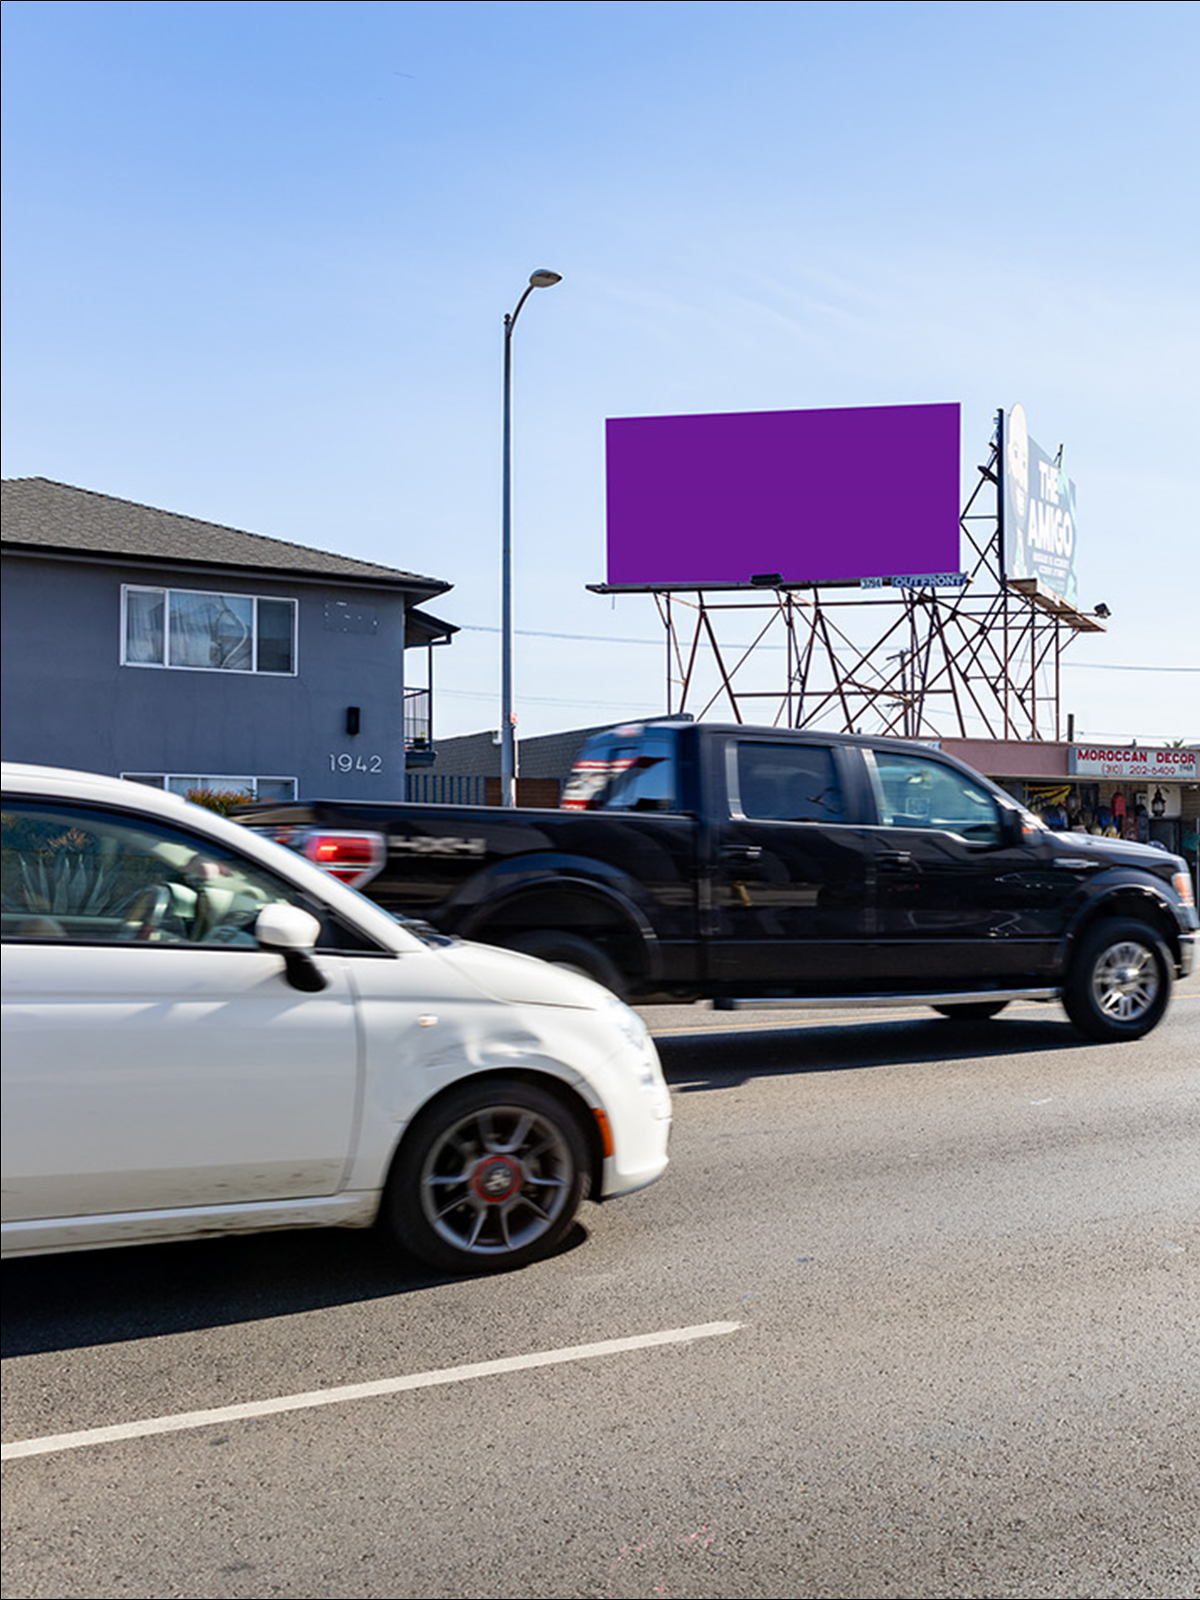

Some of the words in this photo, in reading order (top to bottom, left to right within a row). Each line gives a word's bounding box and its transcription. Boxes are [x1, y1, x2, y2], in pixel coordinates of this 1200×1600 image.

[1039, 460, 1060, 505] THE
[1028, 497, 1073, 558] AMIGO
[895, 576, 964, 587] OUTFRONT
[329, 754, 382, 773] 1942
[1077, 750, 1147, 763] MOROCCAN
[1156, 752, 1196, 764] DECOR
[1101, 764, 1123, 775] (310)
[1129, 765, 1176, 775] 202-6409
